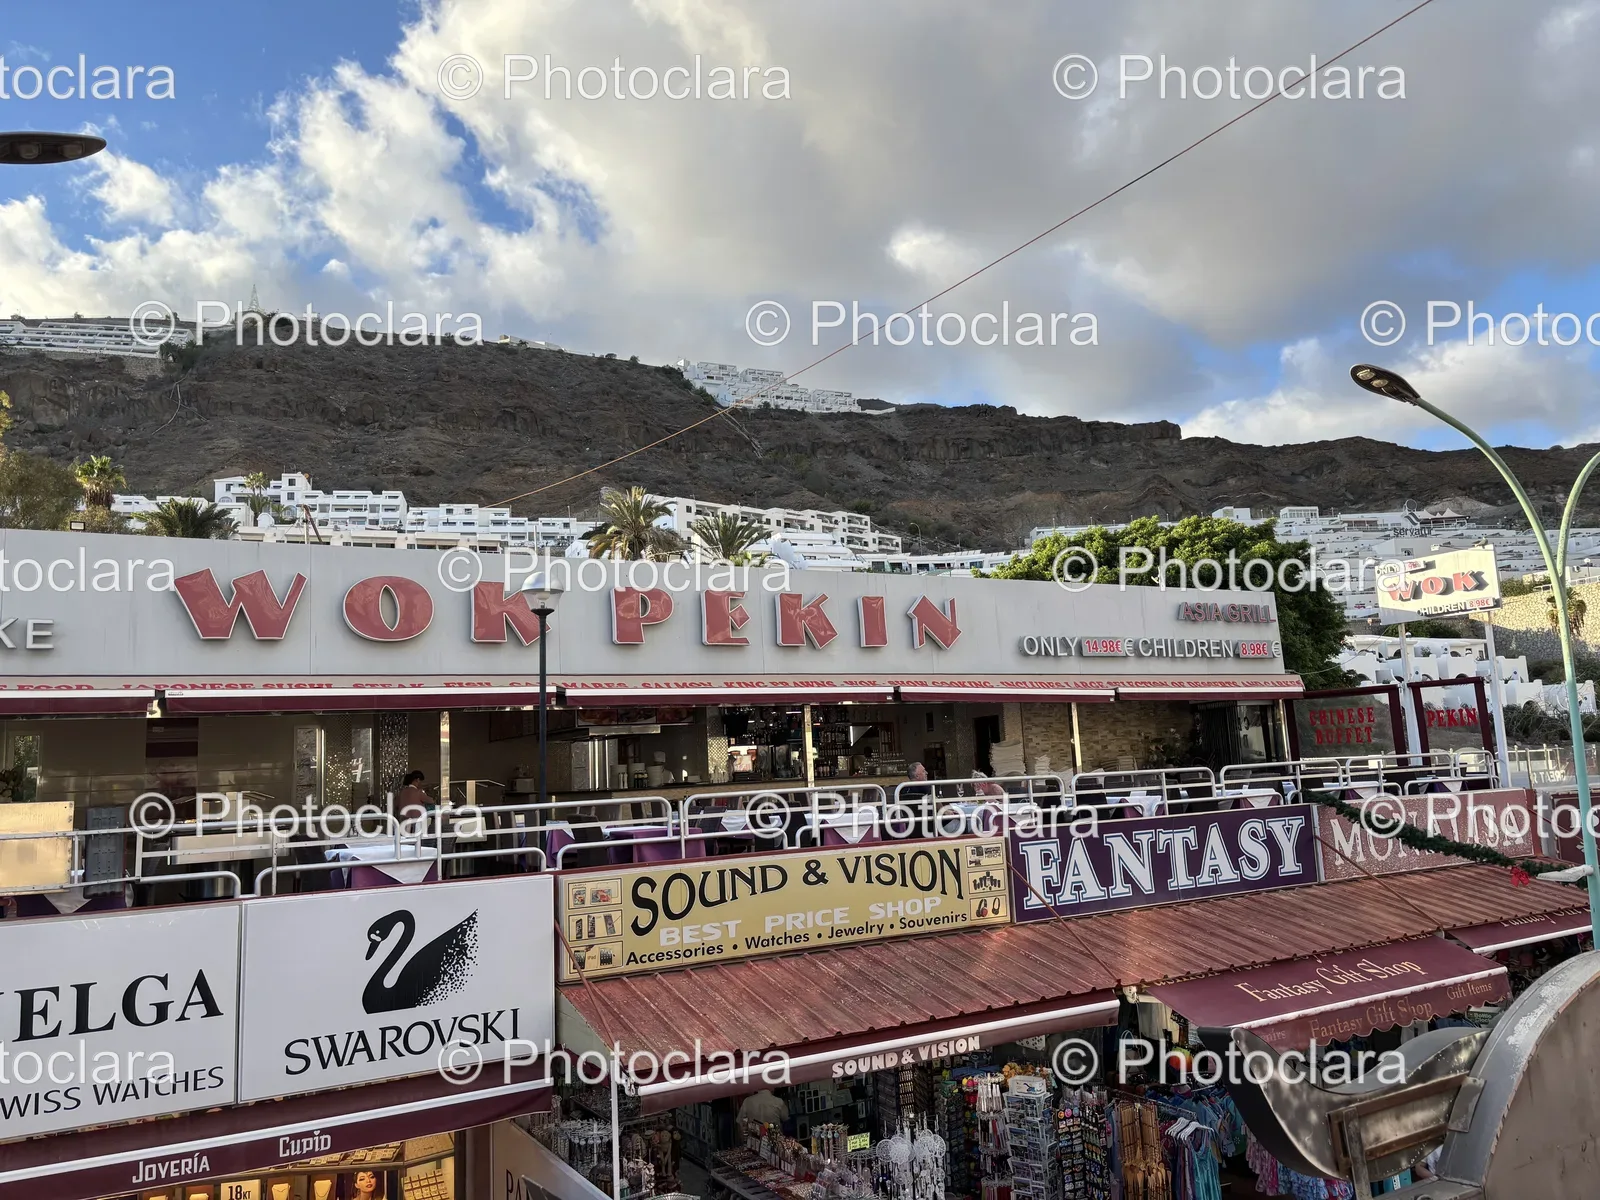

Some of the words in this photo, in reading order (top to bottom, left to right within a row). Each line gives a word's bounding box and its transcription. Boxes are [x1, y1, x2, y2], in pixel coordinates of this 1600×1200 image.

[1393, 527, 1433, 536] servatur
[1387, 570, 1478, 601] WOK
[173, 567, 552, 647] WOK
[610, 586, 963, 650] PEKIN
[1178, 601, 1223, 621] ASIA
[1224, 602, 1276, 623] GRILL
[1020, 636, 1078, 657] ONLY
[1084, 639, 1123, 654] 14.98€
[1137, 637, 1234, 658] CHILDREN
[1240, 642, 1268, 656] 8.98€
[1309, 706, 1376, 726] CHINESE
[1315, 726, 1373, 745] BUFFET
[1426, 708, 1478, 728] PEKIN
[1019, 815, 1305, 911] FANTASY
[631, 864, 788, 936] SOUND
[802, 858, 829, 886] &
[836, 847, 964, 901] VISION
[625, 942, 724, 966] Accessories
[745, 928, 810, 950] Watches
[828, 920, 885, 940] Jewelry
[899, 910, 968, 930] Souvenirs
[659, 919, 742, 947] BEST
[764, 906, 850, 934] PRICE
[868, 895, 942, 920] SHOP
[1234, 977, 1333, 1002] Fantasy
[1316, 964, 1373, 985] Gift
[1356, 958, 1429, 980] Shop
[1446, 984, 1467, 1000] Gift
[1467, 981, 1493, 997] Items
[0, 968, 224, 1043] ELGA
[1309, 1015, 1364, 1040] Fantasy
[1365, 999, 1394, 1029] Gift
[1396, 996, 1433, 1020] Shop
[284, 1007, 521, 1077] SWAROVSKI
[831, 1051, 899, 1079] SOUND
[900, 1047, 915, 1065] &
[918, 1035, 981, 1061] VISION
[92, 1066, 225, 1106] WATCHES
